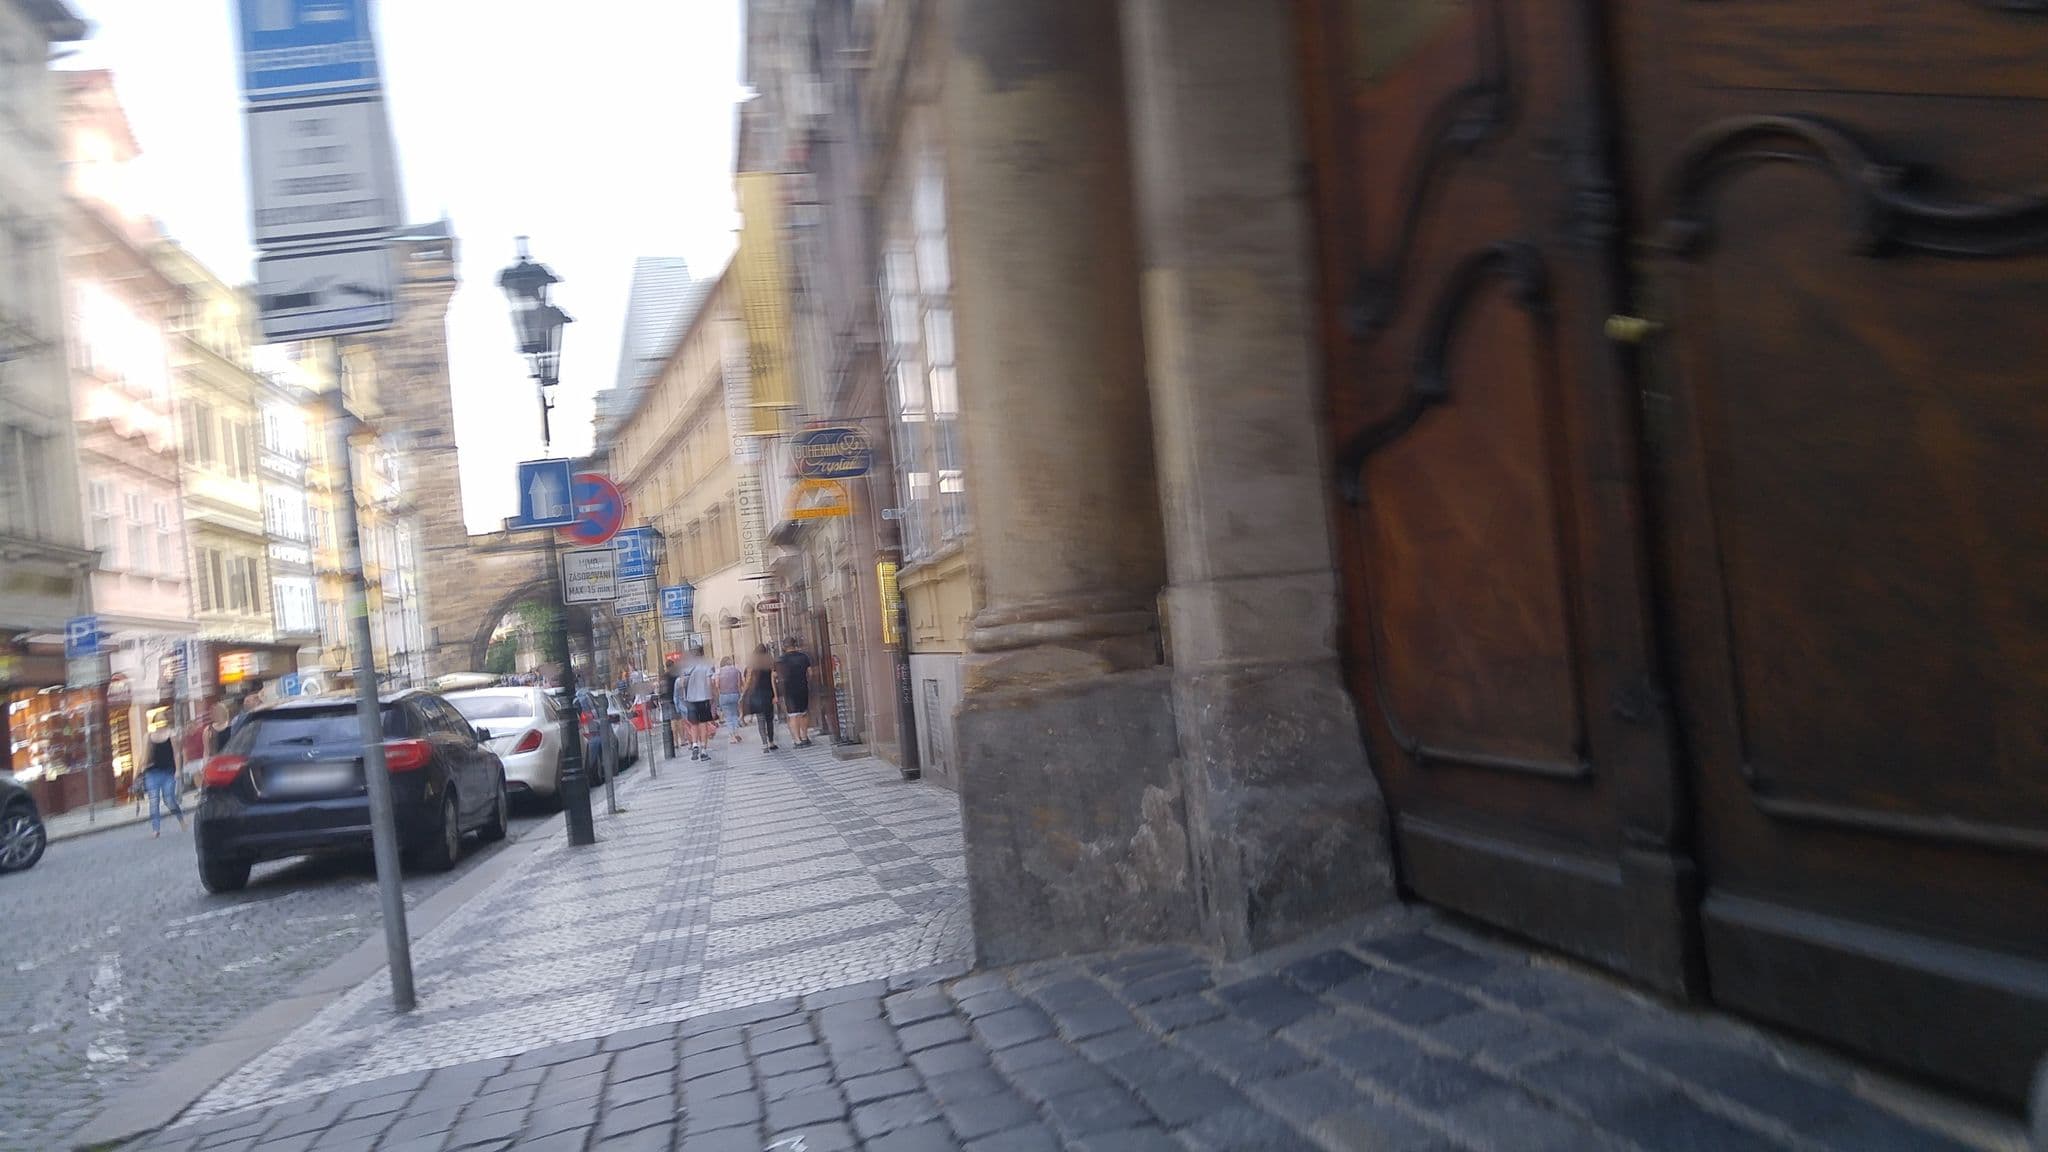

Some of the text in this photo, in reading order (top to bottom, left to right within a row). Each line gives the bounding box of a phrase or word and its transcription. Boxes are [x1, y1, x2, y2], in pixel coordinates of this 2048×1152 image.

[737, 473, 755, 564] DESIGN HOTEL
[664, 591, 677, 609] P
[71, 621, 89, 647] P
[285, 679, 296, 695] P
